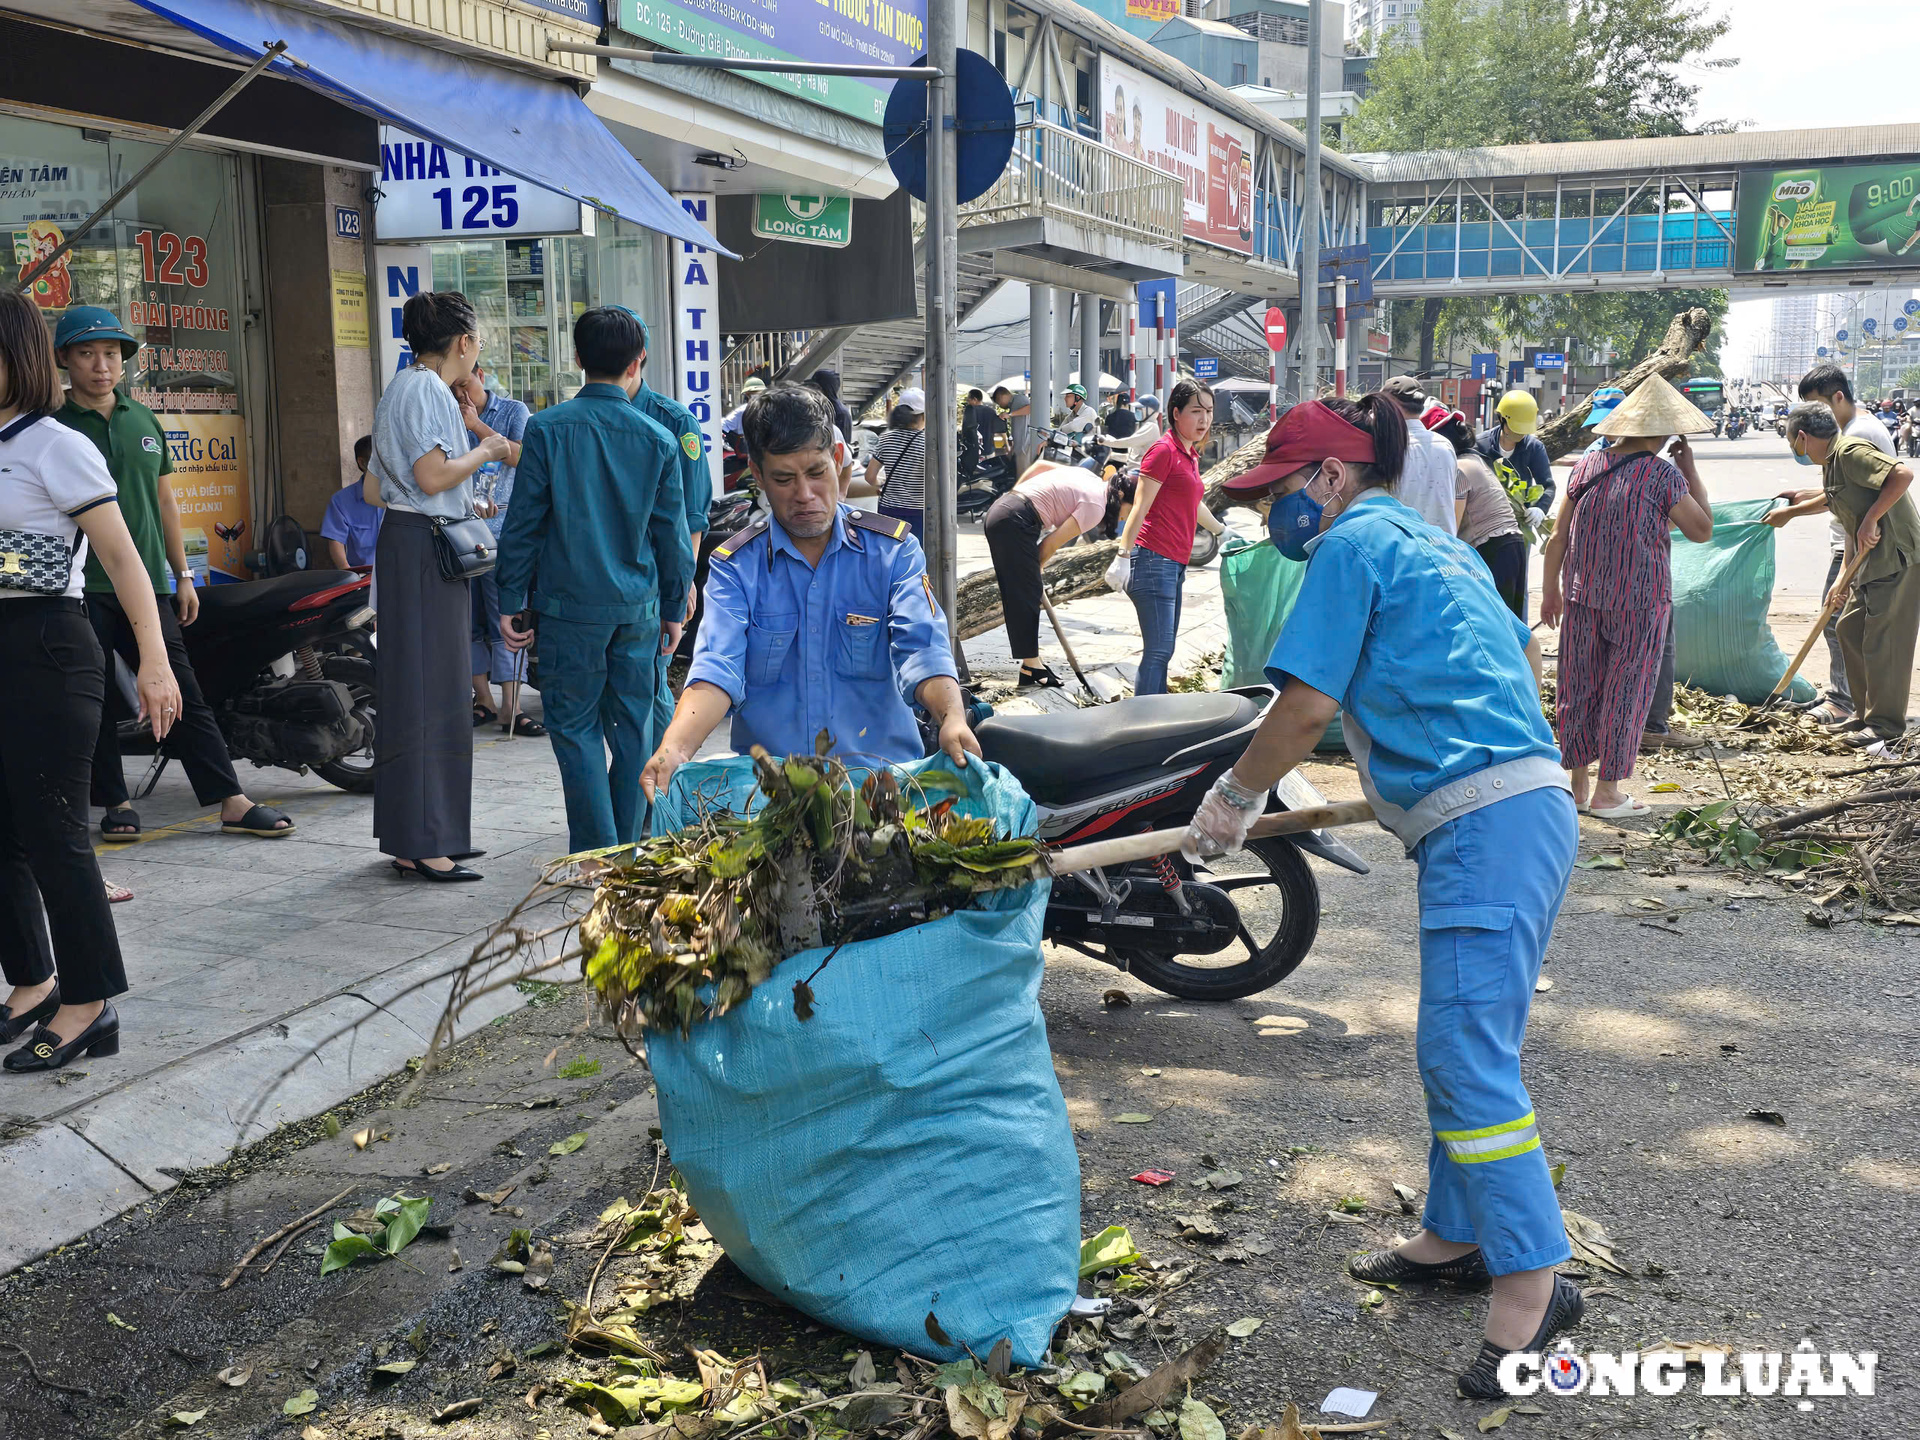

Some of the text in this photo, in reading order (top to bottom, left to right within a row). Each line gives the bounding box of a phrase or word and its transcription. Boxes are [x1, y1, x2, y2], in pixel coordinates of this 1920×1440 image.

[657, 12, 671, 33] 125
[679, 20, 706, 52] Đường
[819, 20, 830, 37] GIỜ
[896, 10, 923, 54] DƯỢC
[29, 165, 68, 182] TÂM
[1778, 185, 1811, 196] MILO
[1868, 176, 1914, 208] 9:00
[433, 184, 519, 230] 125
[1794, 210, 1832, 221] CHỨNG MINH
[1797, 201, 1817, 214] NAY
[338, 212, 360, 235] 123
[765, 219, 842, 240] LONG TÂM
[1793, 217, 1830, 228] KHOA HỌC
[135, 230, 209, 288] 123
[130, 291, 229, 332] GIẢI PHÓNG
[139, 348, 158, 371] ĐT:
[168, 436, 237, 461] xtG Cal
[195, 502, 222, 513] CANXI
[1097, 778, 1187, 815] BLADE
